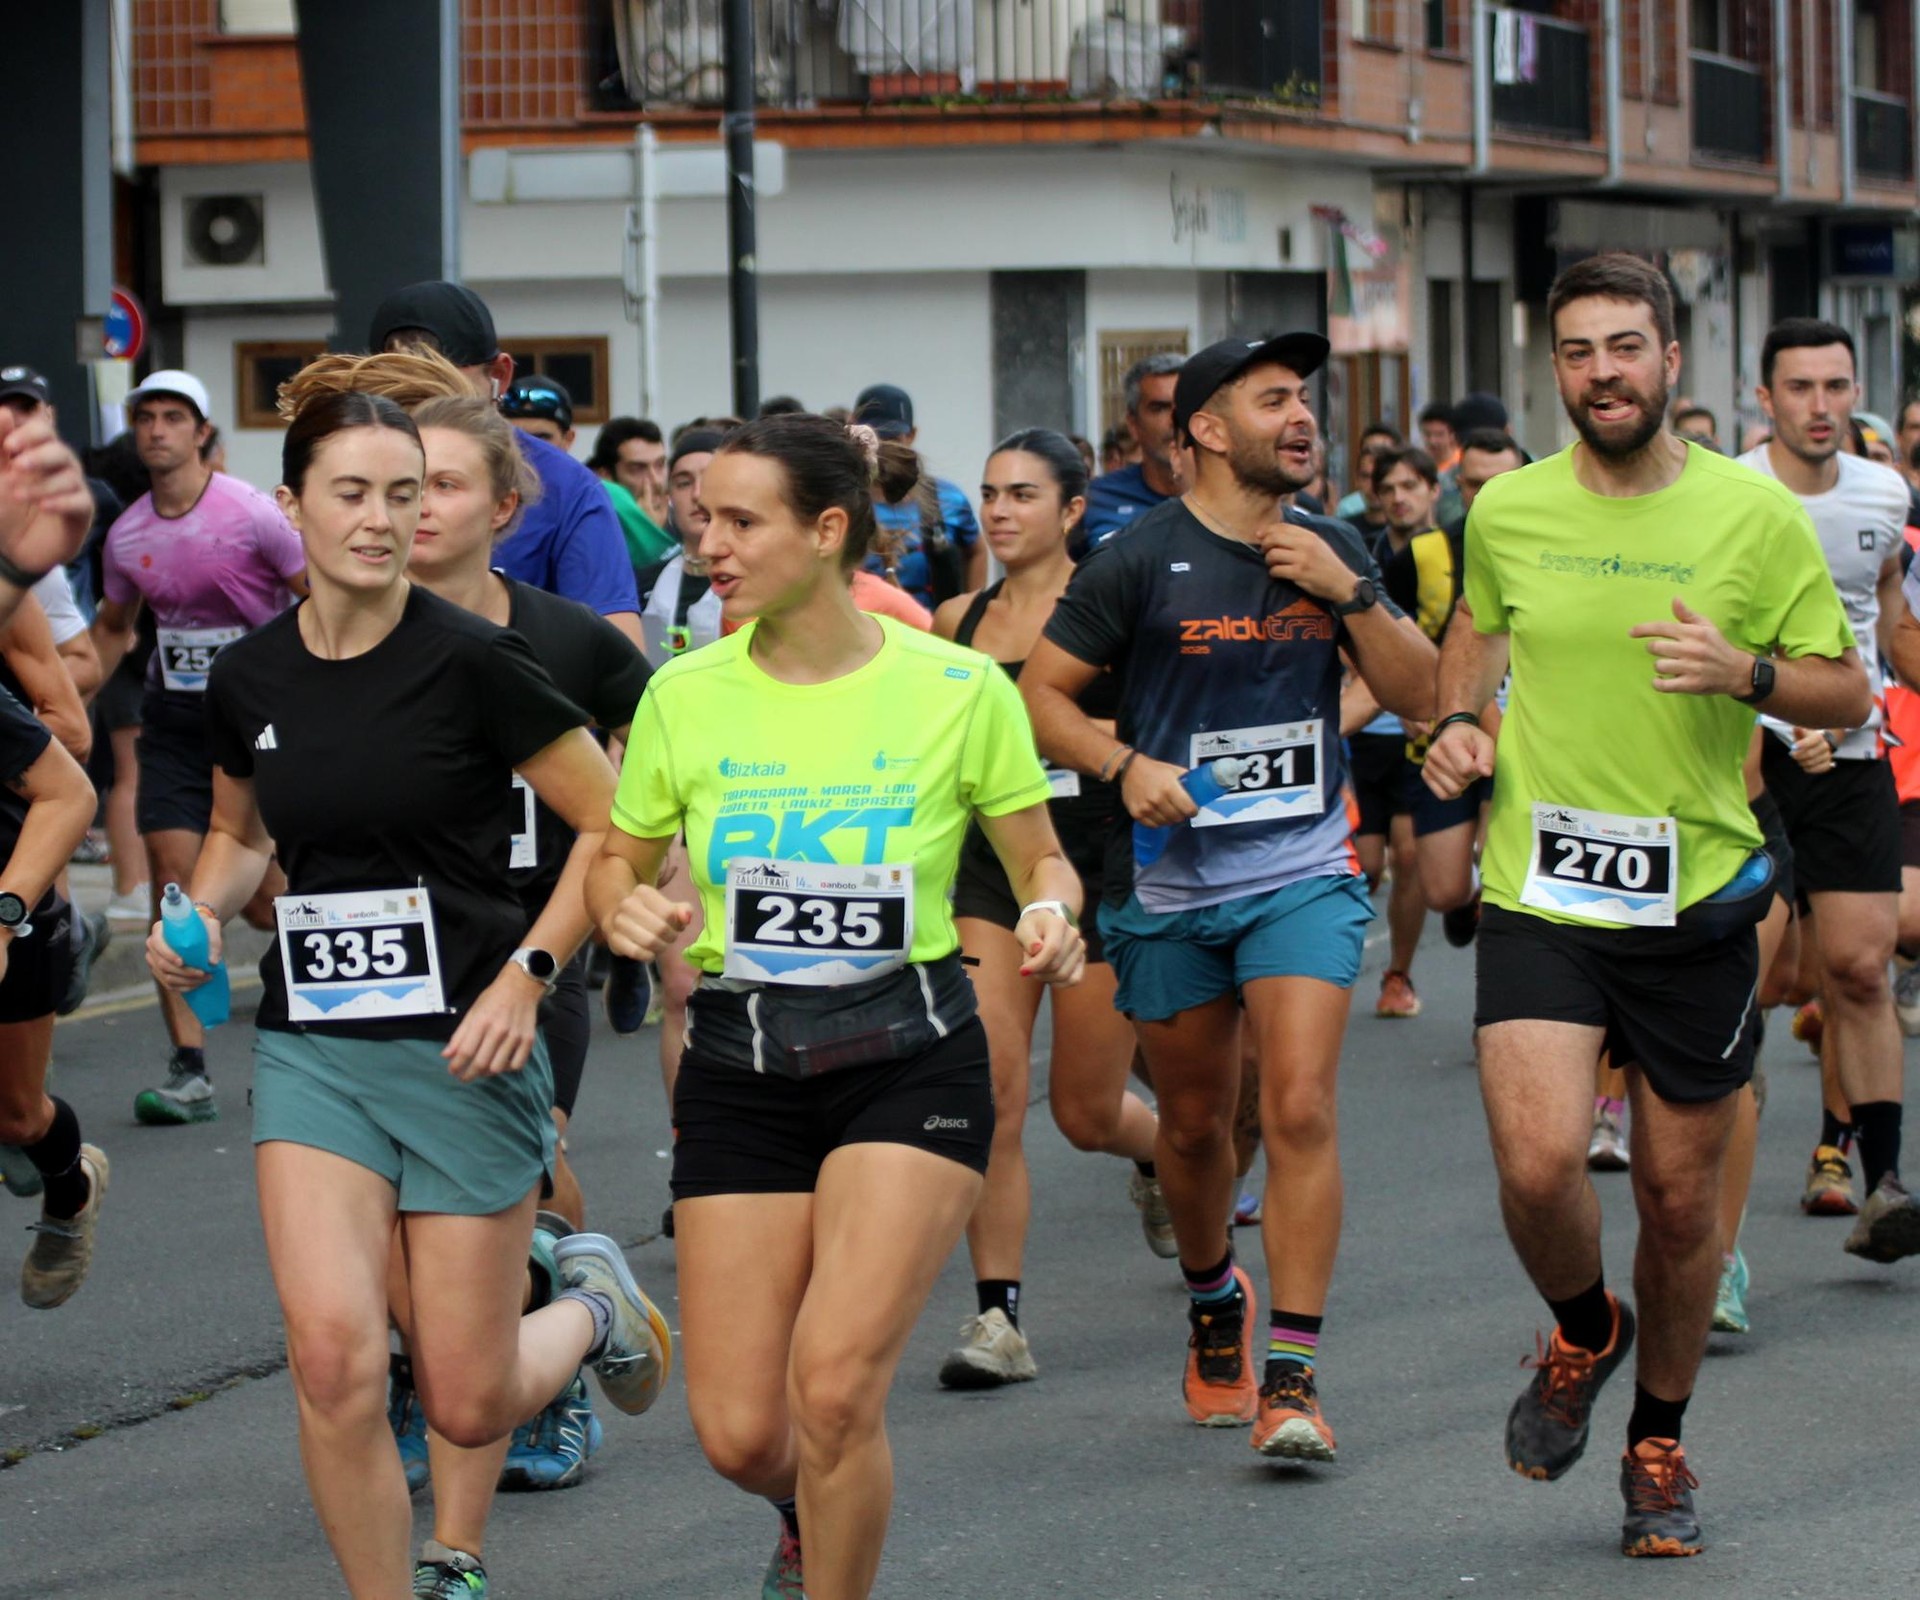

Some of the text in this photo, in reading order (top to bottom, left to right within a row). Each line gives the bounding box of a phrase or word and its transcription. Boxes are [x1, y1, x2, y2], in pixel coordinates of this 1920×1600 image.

[172, 647, 213, 671] 25
[729, 761, 786, 778] Bizkaia
[781, 798, 832, 810] LAUKIZ
[845, 796, 916, 807] ISPASTER
[821, 785, 871, 795] MORGA
[707, 807, 915, 885] BKT
[1552, 837, 1650, 890] 270
[754, 895, 881, 947] 235
[304, 928, 407, 979] 335
